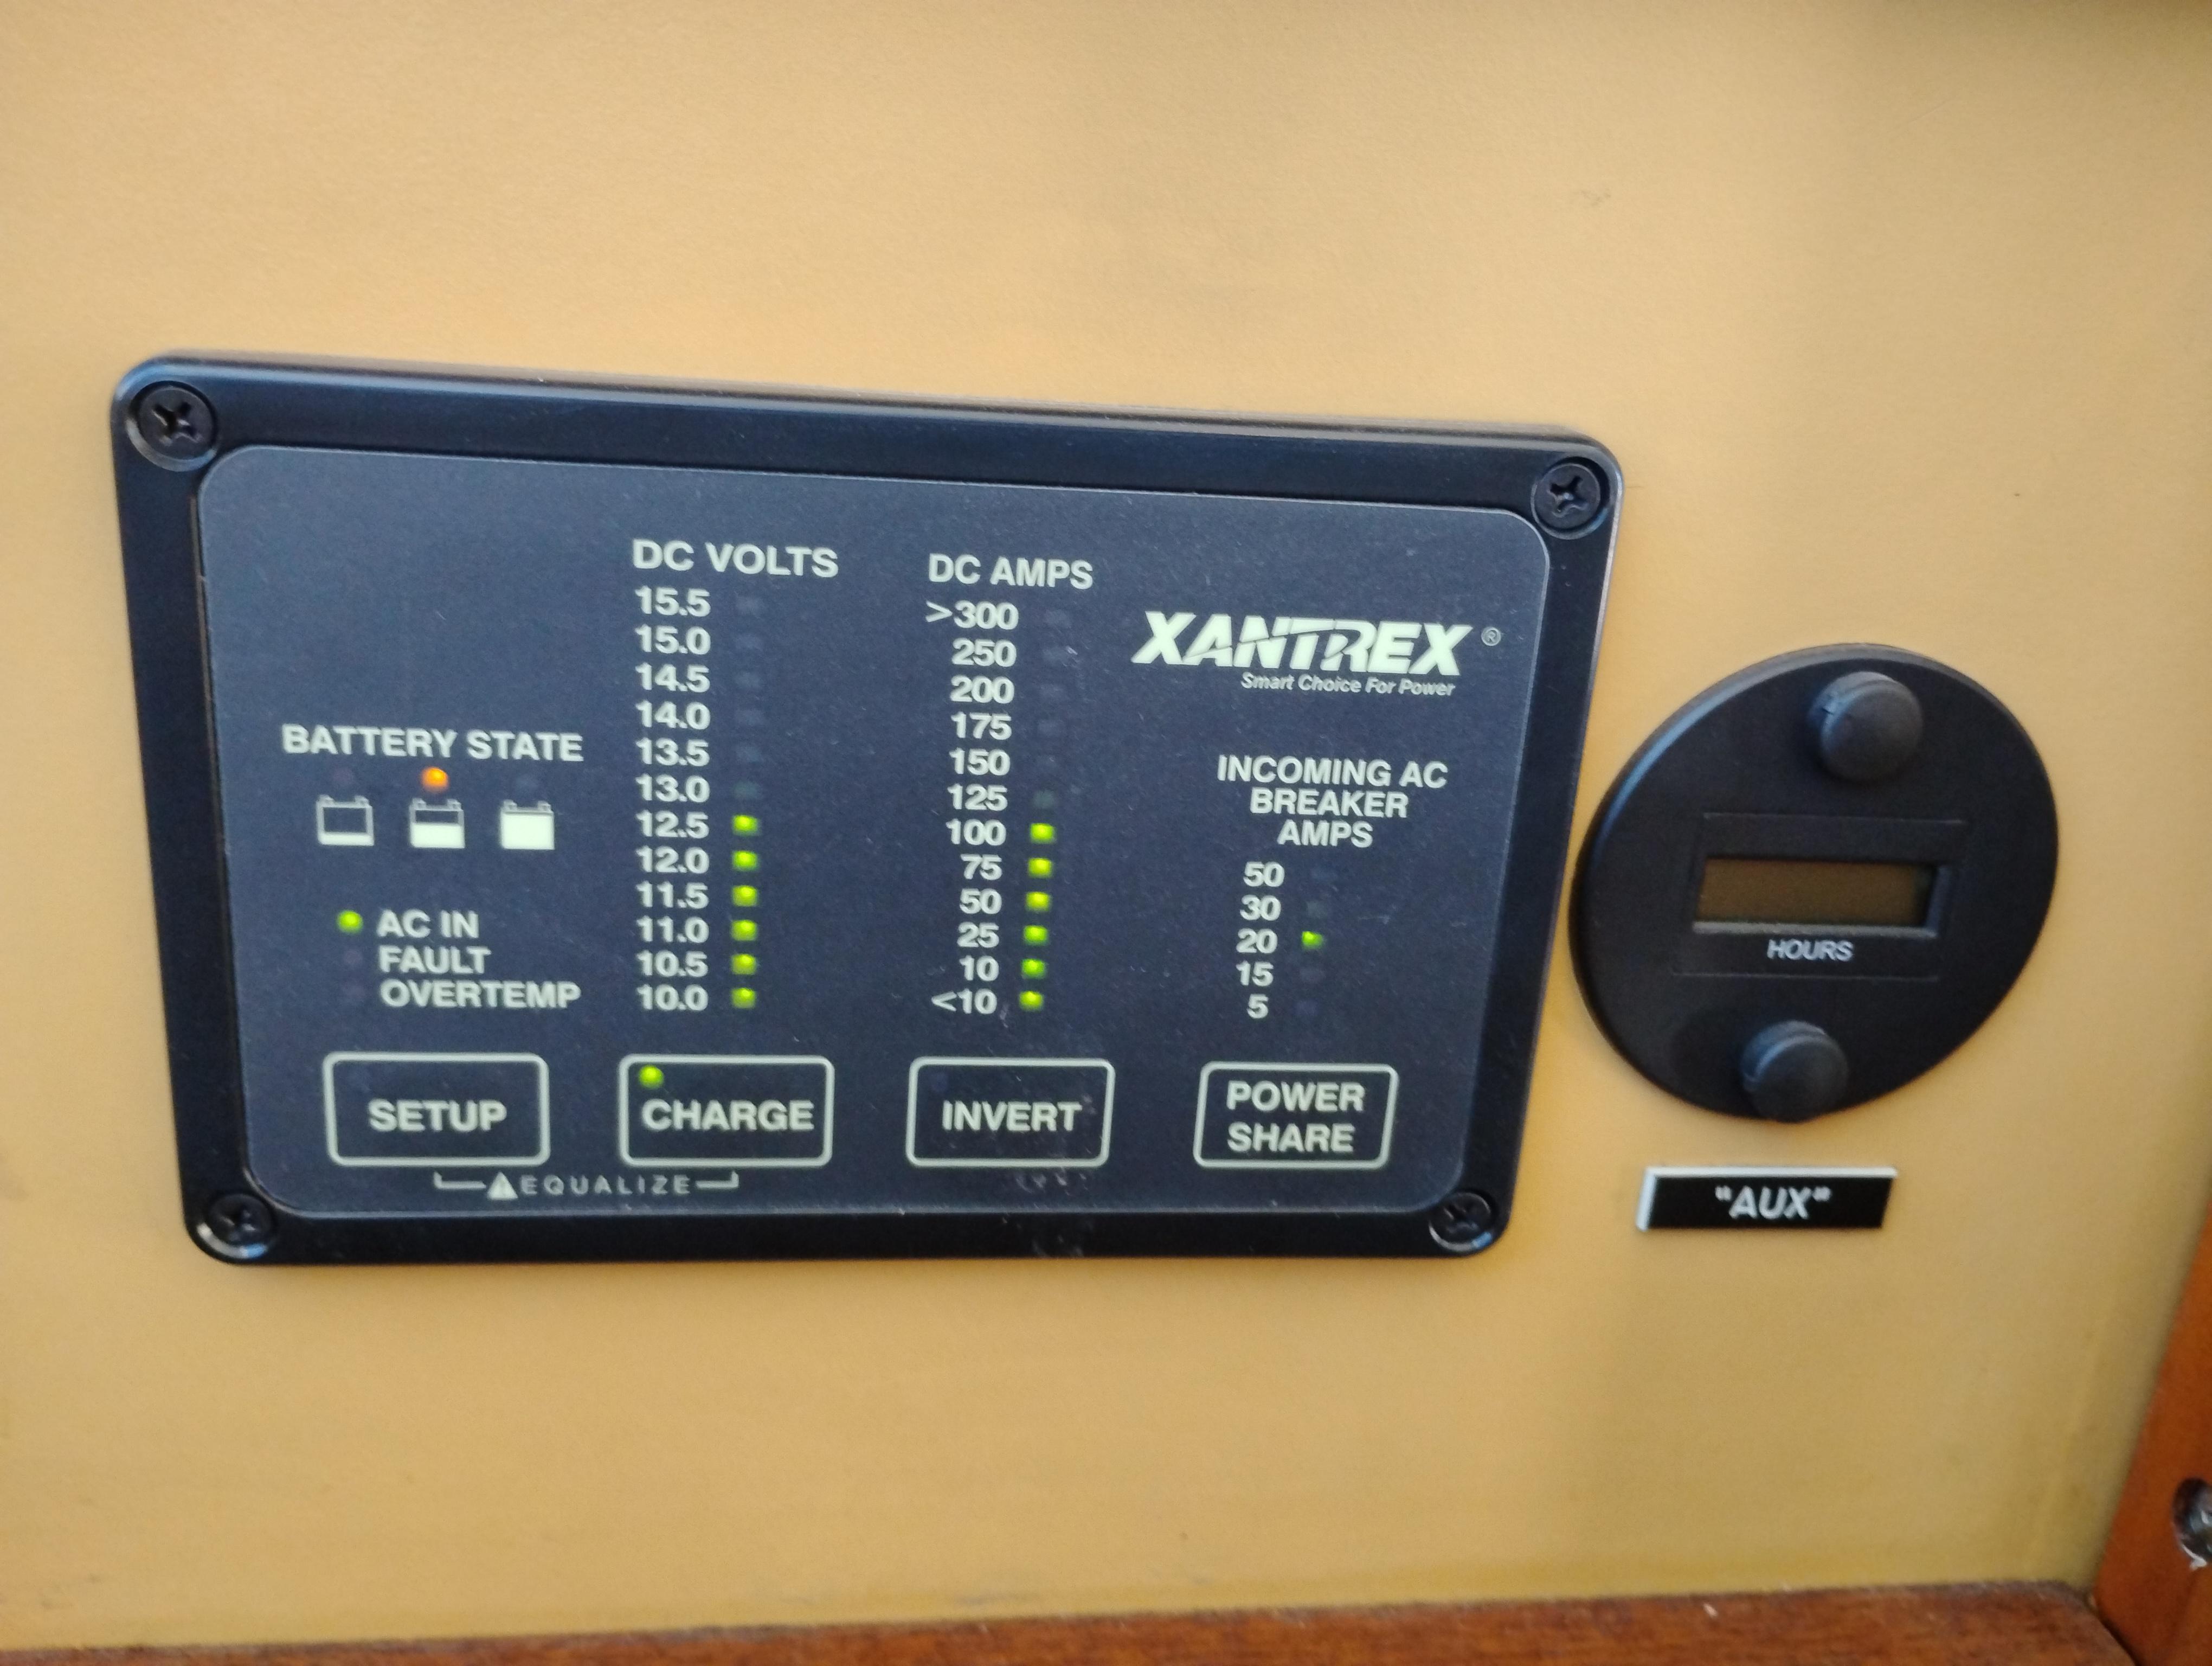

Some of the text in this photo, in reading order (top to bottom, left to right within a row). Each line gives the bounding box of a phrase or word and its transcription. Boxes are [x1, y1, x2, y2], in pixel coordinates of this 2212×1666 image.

[633, 539, 839, 578] DC VOLTS
[928, 553, 1093, 590] DC AMPS
[635, 586, 711, 617] 15.5
[925, 600, 1019, 630] >300
[635, 624, 711, 655] 15.0
[951, 638, 1017, 668] 250
[1131, 611, 1473, 676] XANTREX
[635, 662, 710, 693] 14.5
[950, 675, 1015, 704] 200
[1240, 671, 1456, 696] Smart Choice For Power
[635, 700, 711, 730] 14.0
[951, 712, 1012, 740] 175
[282, 724, 583, 762] BATTERY STATE
[635, 737, 710, 767] 13.5
[949, 748, 1011, 776] 150
[1217, 754, 1448, 789] INCOMING AC
[635, 774, 710, 803] 13.0
[947, 784, 1008, 811] 125
[1250, 787, 1409, 818] BREAKER
[636, 810, 709, 839] 12.5
[946, 818, 1006, 846] 100
[1277, 819, 1373, 848] AMPS
[636, 845, 710, 874] 12.0
[961, 854, 1002, 881] 75
[1243, 862, 1285, 887] 50
[636, 881, 709, 909] 11.5
[960, 888, 1002, 914] 50
[1240, 895, 1281, 921] 30
[377, 909, 479, 938] AC IN
[636, 915, 709, 944] 11.0
[957, 922, 999, 949] 25
[1236, 928, 1278, 954] 20
[1767, 939, 1854, 962] HOURS
[378, 945, 491, 974] FAULT
[636, 950, 708, 978] 10.5
[960, 955, 999, 982] 10
[1236, 961, 1274, 987] 15
[380, 979, 581, 1008] OVERTEMP
[637, 984, 708, 1011] 10.0
[931, 989, 998, 1015] <10
[1247, 994, 1269, 1019] 5
[1226, 1080, 1365, 1112] POWER
[368, 1099, 507, 1132] SETUP
[641, 1099, 814, 1131] CHARGE
[942, 1101, 1083, 1132] INVERT
[1227, 1122, 1355, 1152] SHARE
[520, 1175, 690, 1196] EQUALIZE
